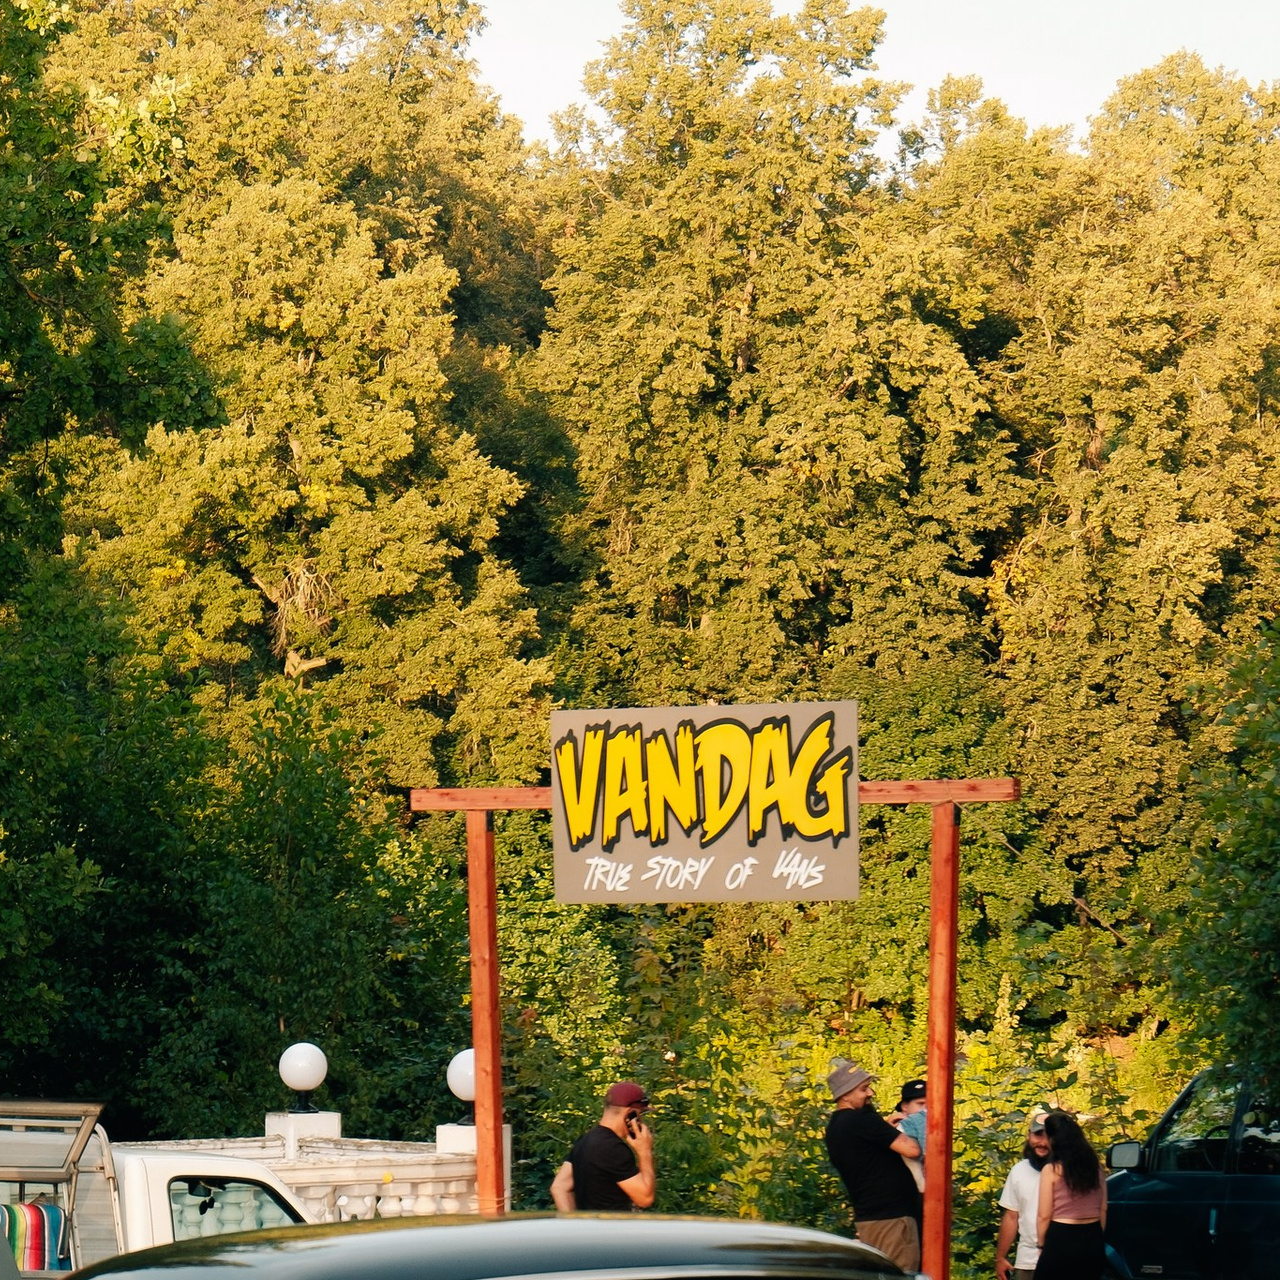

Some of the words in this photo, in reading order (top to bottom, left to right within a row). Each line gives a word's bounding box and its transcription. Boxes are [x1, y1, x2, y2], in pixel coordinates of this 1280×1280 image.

[555, 710, 852, 853] VANDAG
[583, 855, 635, 892] TRUE
[641, 854, 715, 891] STORY
[724, 856, 760, 891] OF
[772, 847, 826, 891] VANS
